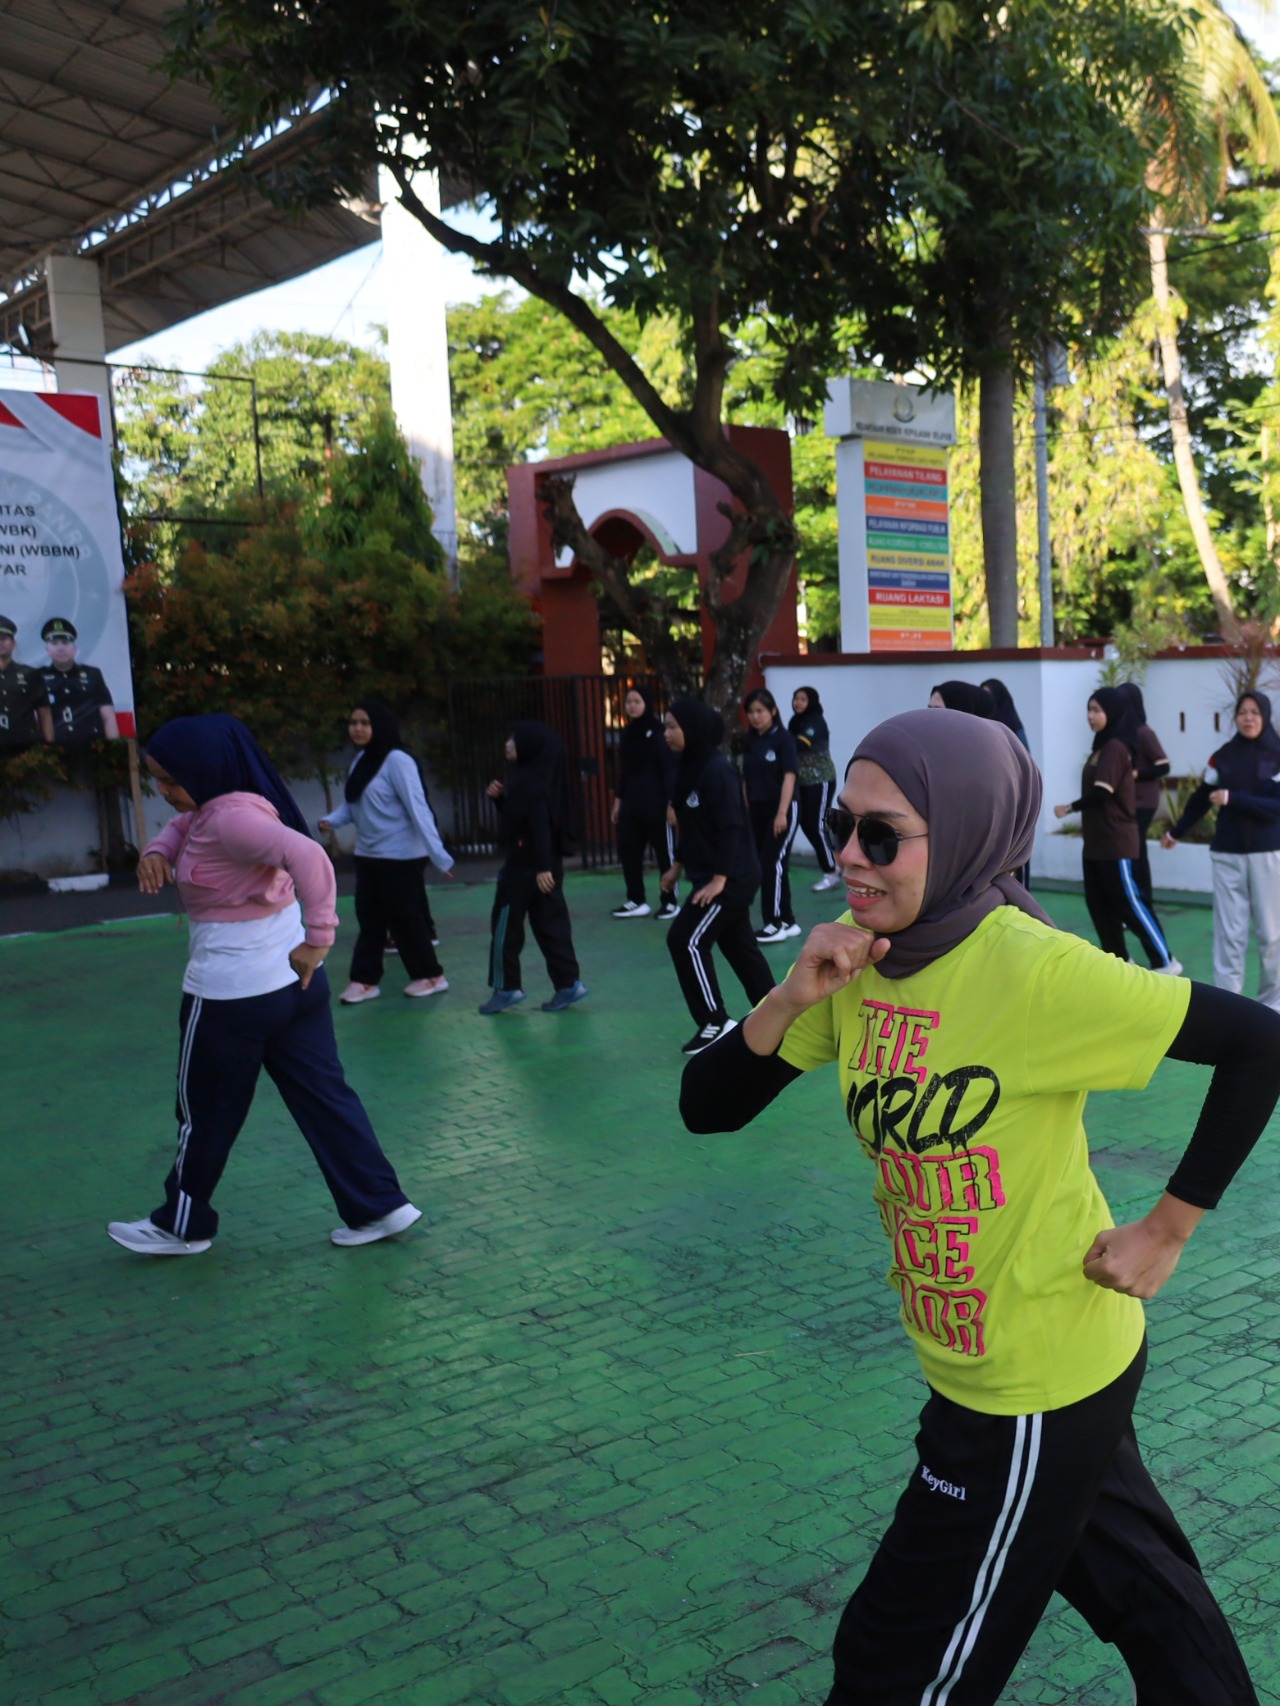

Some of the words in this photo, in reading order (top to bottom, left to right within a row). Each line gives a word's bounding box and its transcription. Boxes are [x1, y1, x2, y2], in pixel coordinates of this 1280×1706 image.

[915, 471, 943, 482] TILANG
[20, 545, 80, 559] (WBBM)
[871, 554, 896, 564] RUANG
[897, 556, 924, 567] DIVERSI
[926, 558, 945, 567] ANAK
[876, 592, 907, 603] RUANG
[908, 594, 944, 604] LAKTASI
[848, 998, 940, 1084] THE
[921, 1465, 966, 1501] KeyGirl
